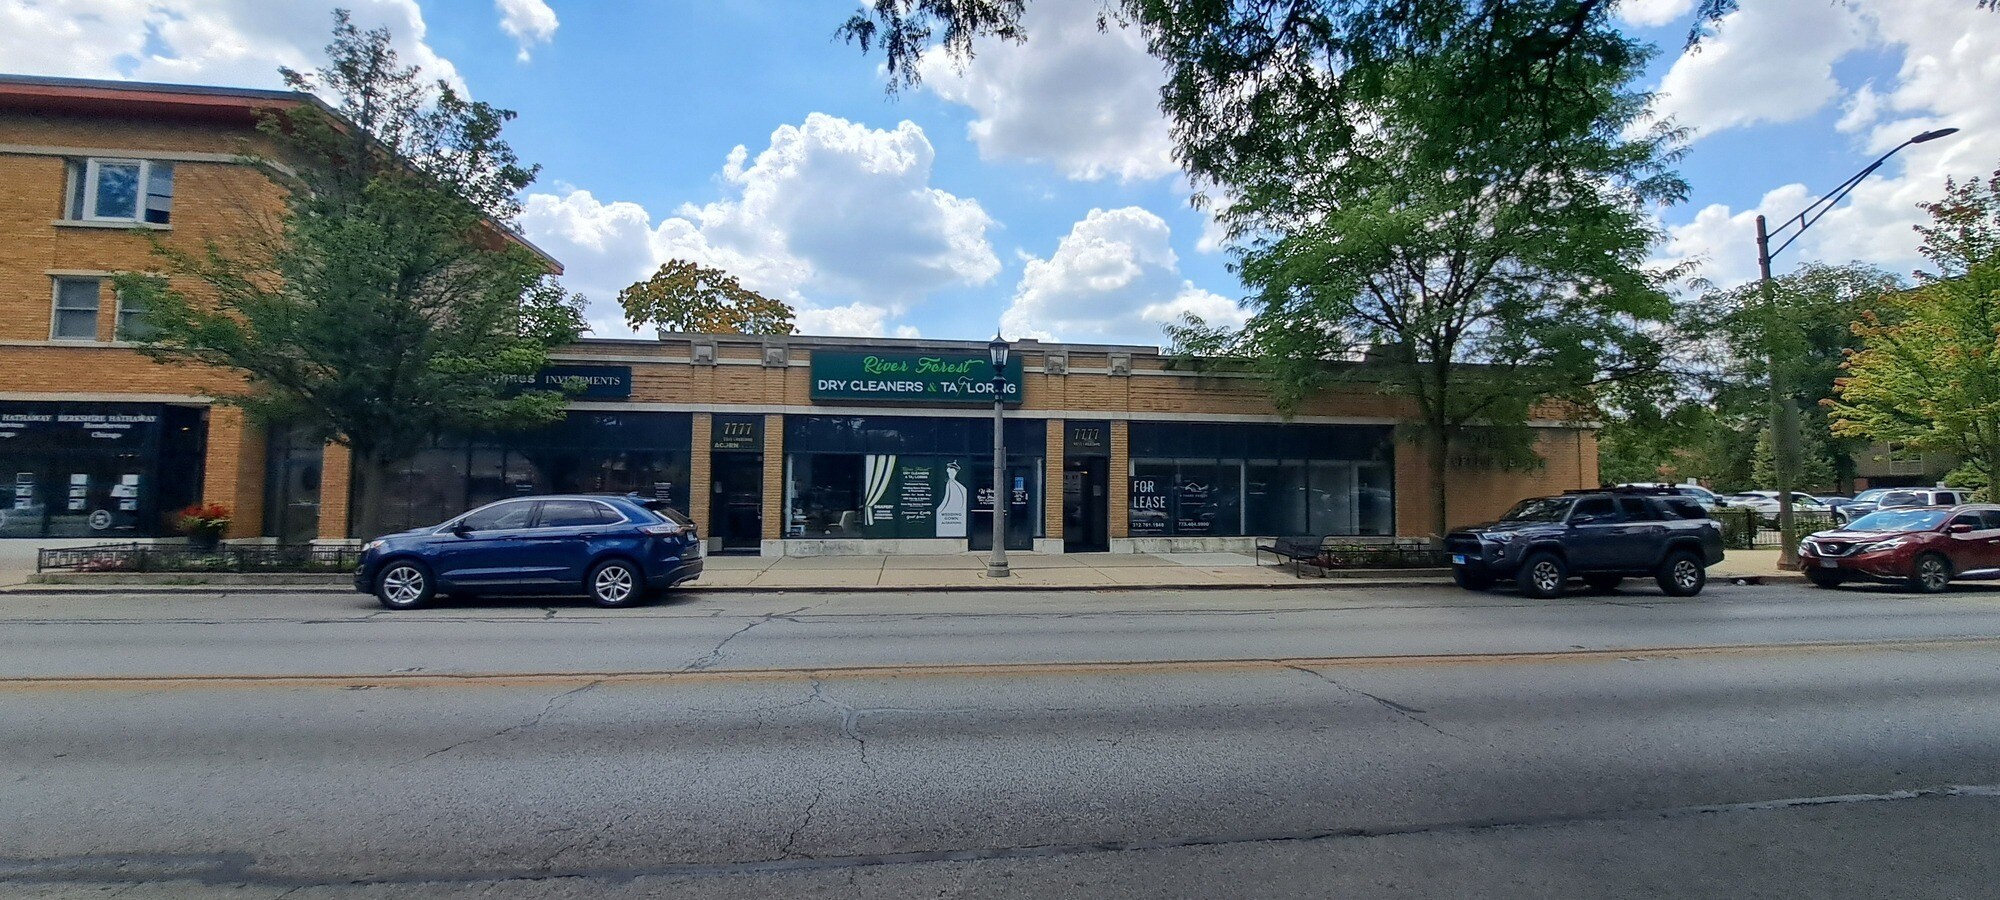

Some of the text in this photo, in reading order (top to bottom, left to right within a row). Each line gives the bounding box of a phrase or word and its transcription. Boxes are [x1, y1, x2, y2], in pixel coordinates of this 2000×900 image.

[864, 355, 984, 375] River Forest
[545, 375, 621, 386] INVEMENTS
[818, 376, 1016, 396] DRY CLEANERS & TAILORNG
[2, 414, 52, 422] HATHAWAY
[108, 415, 157, 423] HATHAWAY
[724, 422, 752, 435] 7777
[1074, 428, 1099, 440] 7777
[1133, 480, 1155, 493] FOR
[1133, 496, 1166, 509] LEASE
